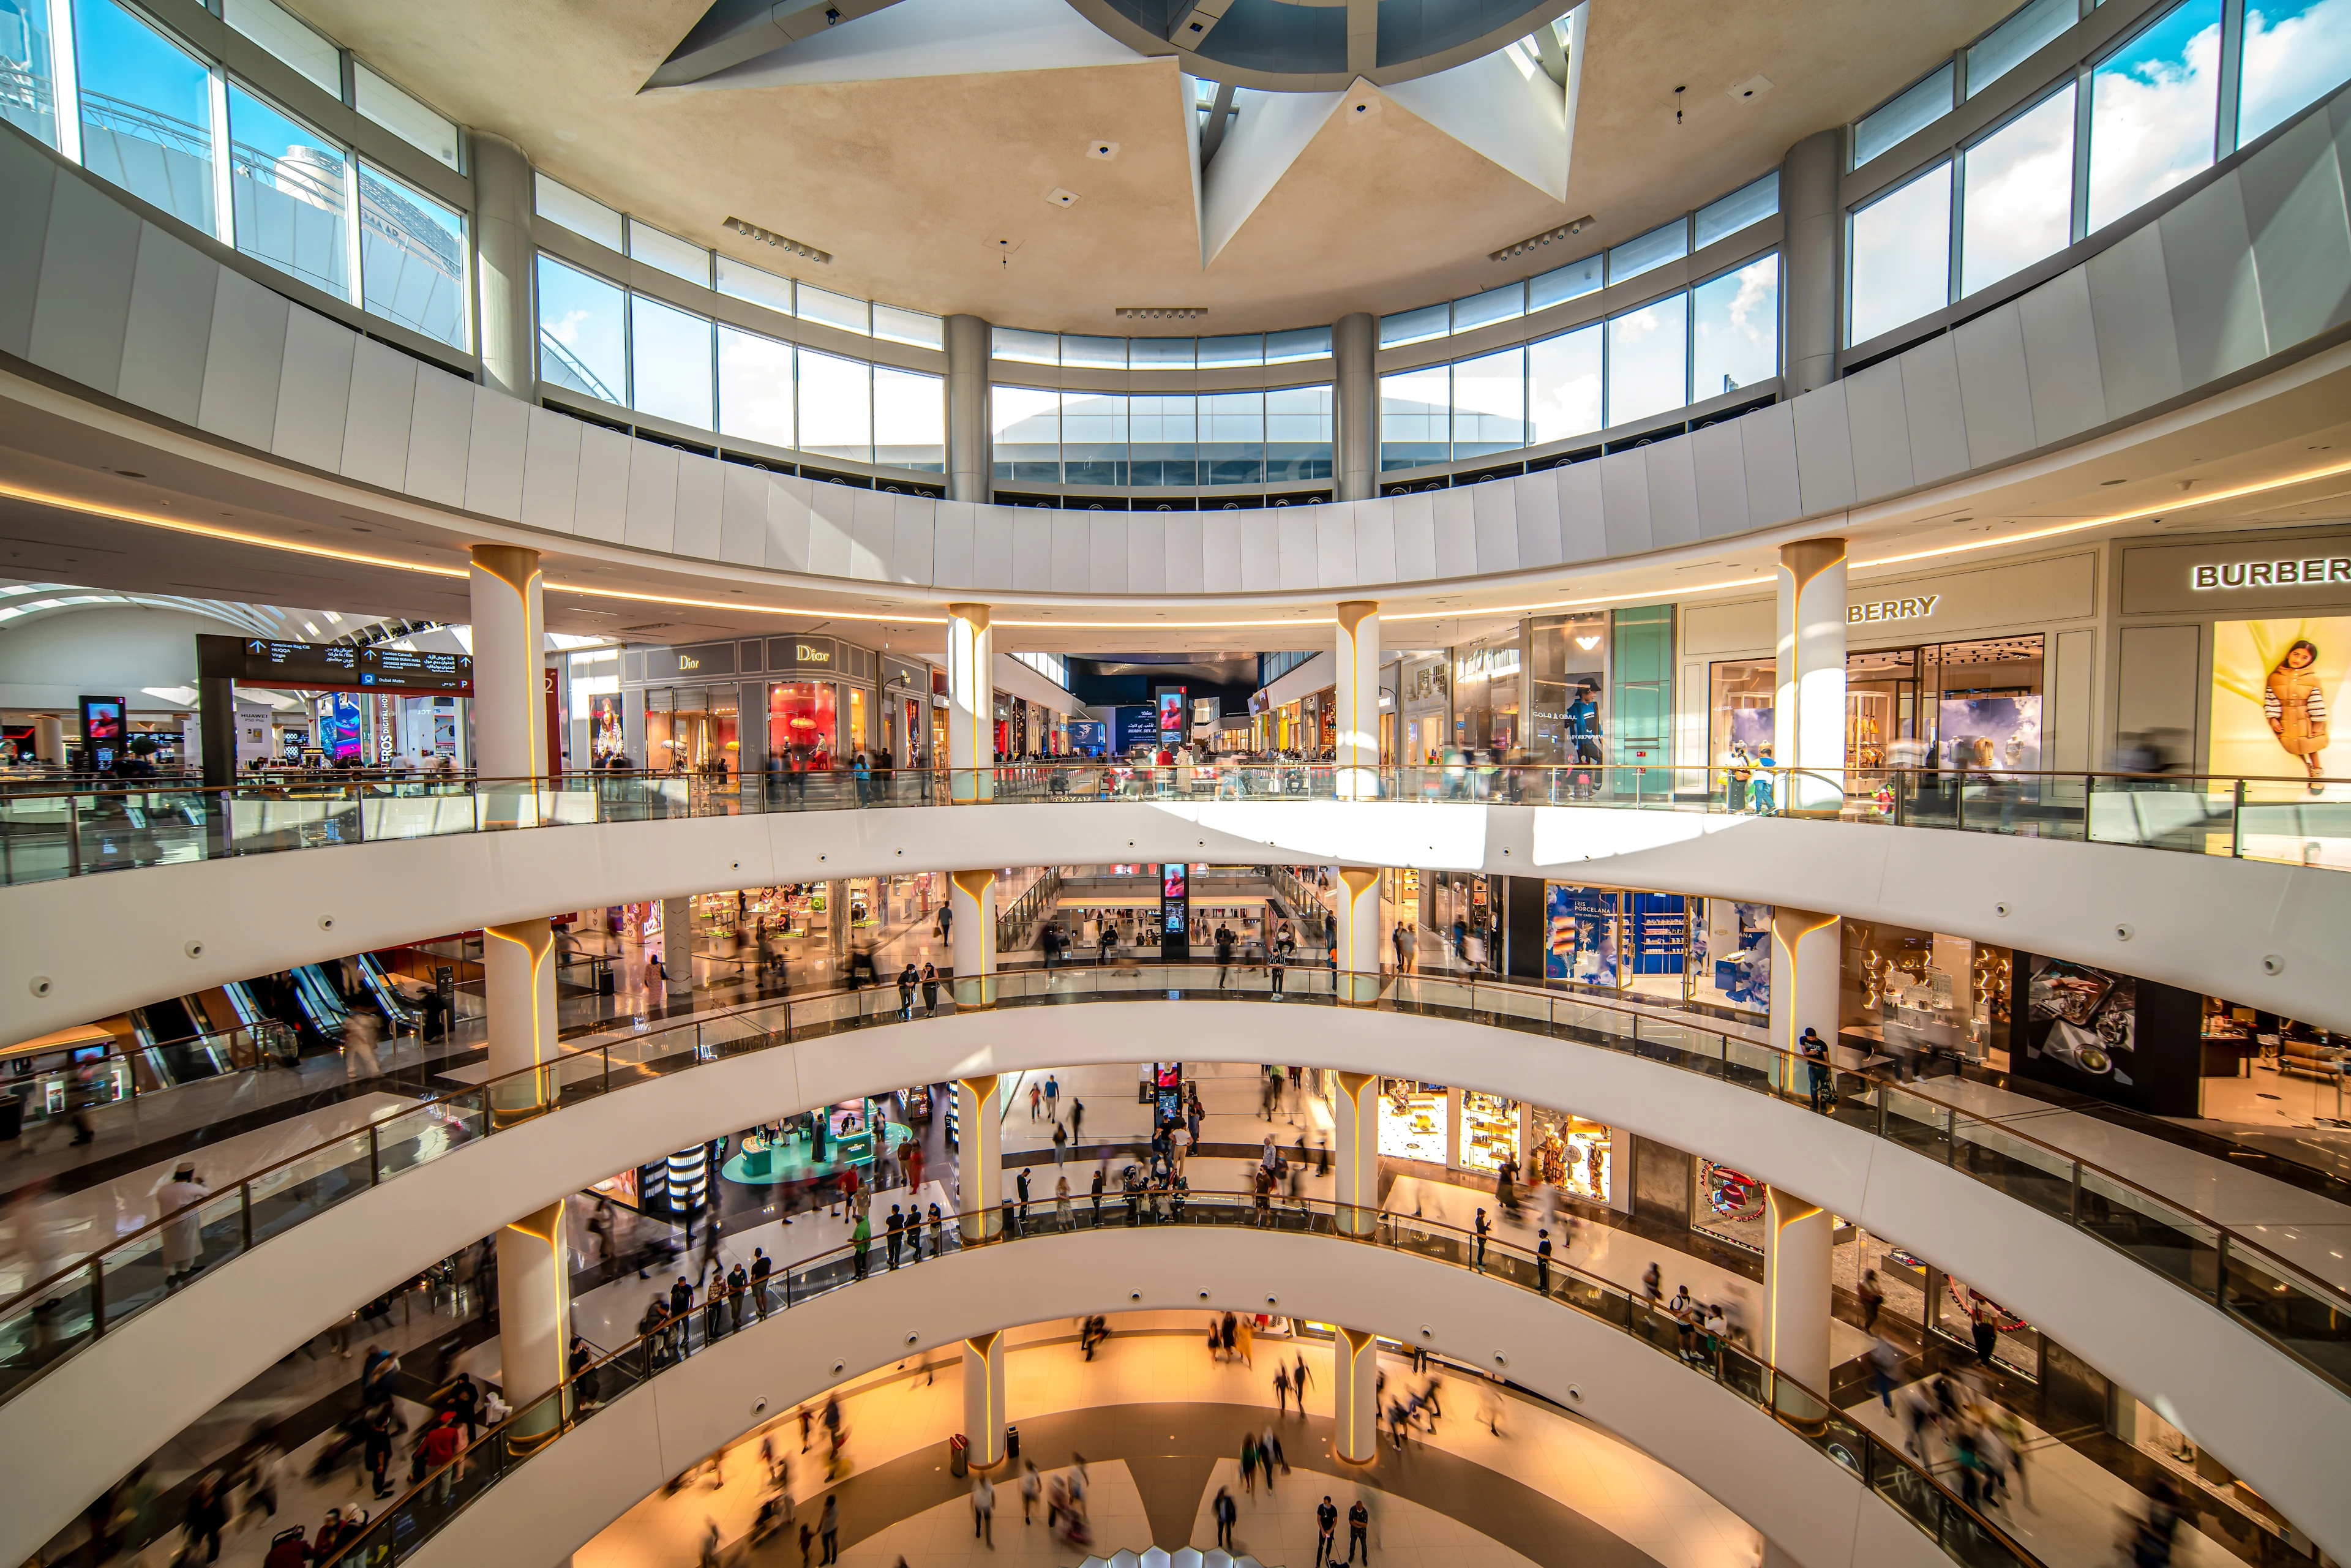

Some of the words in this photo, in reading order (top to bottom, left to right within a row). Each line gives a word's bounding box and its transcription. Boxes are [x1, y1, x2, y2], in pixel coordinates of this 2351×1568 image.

[2193, 558, 2351, 589] BURBER
[1847, 595, 1938, 624] BERRY
[678, 656, 699, 669] Dior
[796, 645, 830, 661] Dior
[380, 735, 392, 762] EROS
[1704, 1194, 1734, 1220] TOMMY
[1736, 1211, 1763, 1223] JEANS
